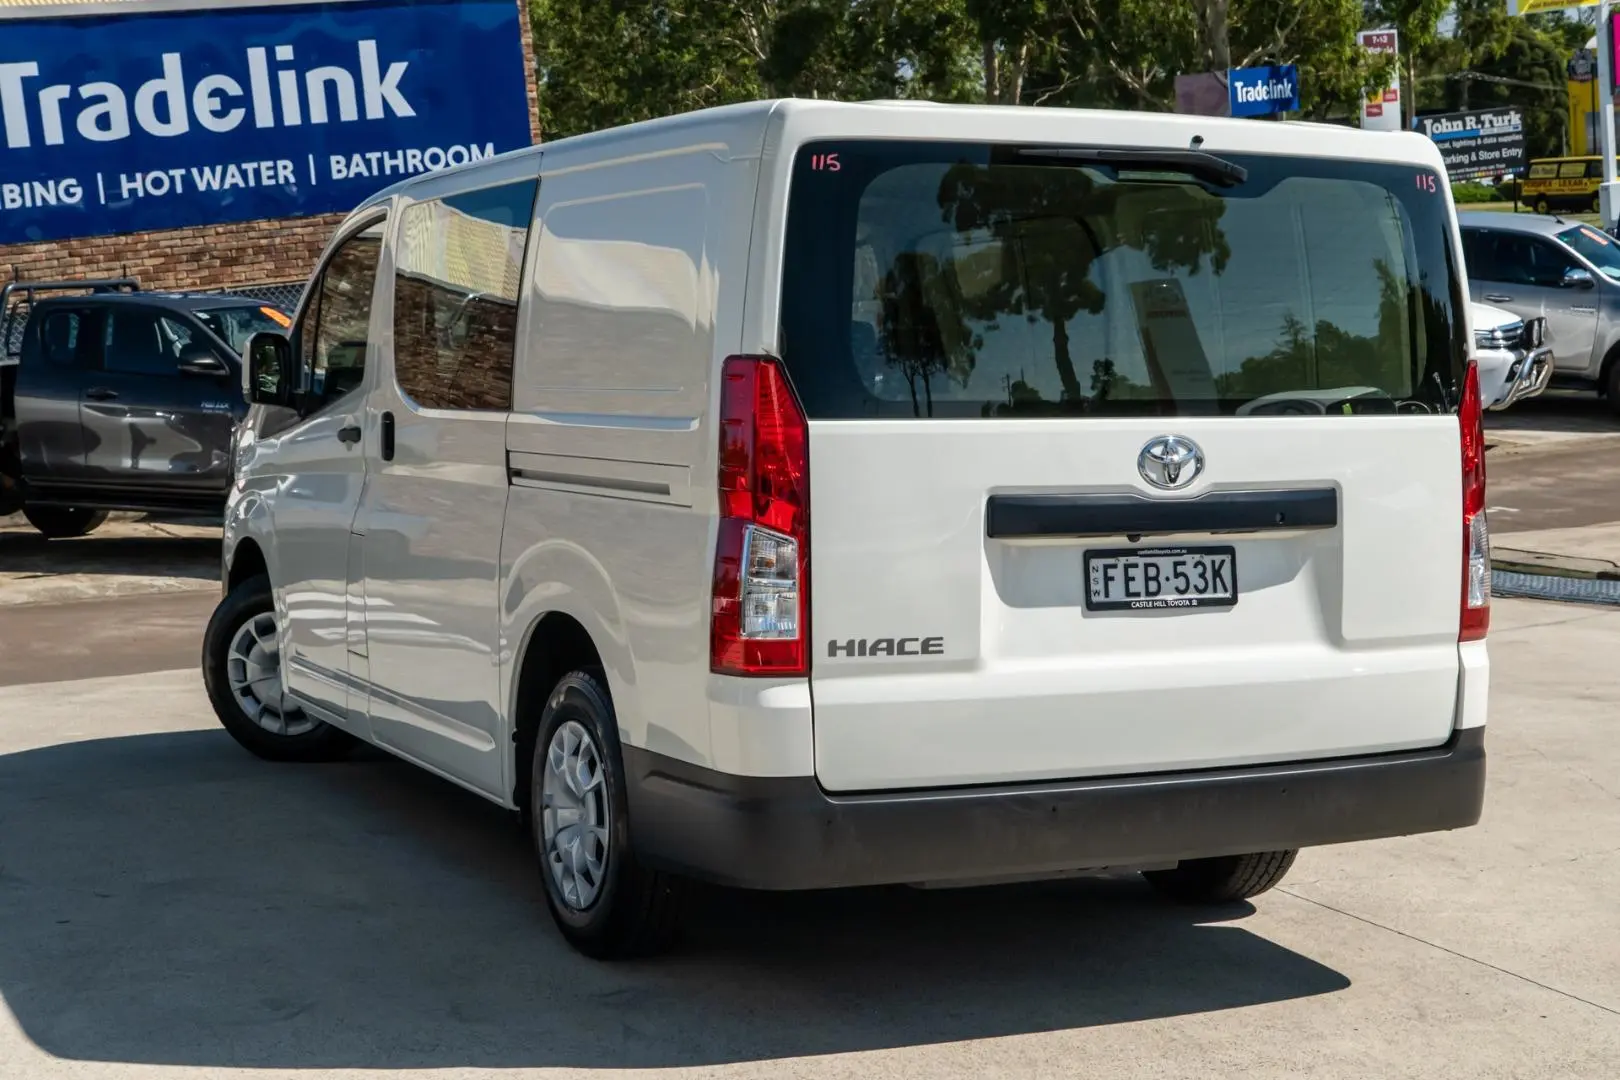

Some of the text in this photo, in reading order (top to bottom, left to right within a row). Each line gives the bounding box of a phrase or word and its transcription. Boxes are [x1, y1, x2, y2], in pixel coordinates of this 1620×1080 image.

[0, 39, 416, 149] Tradelink
[1234, 78, 1293, 103] Tradelink
[1424, 118, 1463, 140] John
[812, 153, 841, 171] 115
[1470, 151, 1477, 162] &
[1479, 150, 1500, 161] Store
[1501, 147, 1523, 158] Entry
[0, 142, 494, 209] BING HOT WATER BATHROOM
[1416, 174, 1436, 192] 115
[828, 636, 944, 657] HIACE
